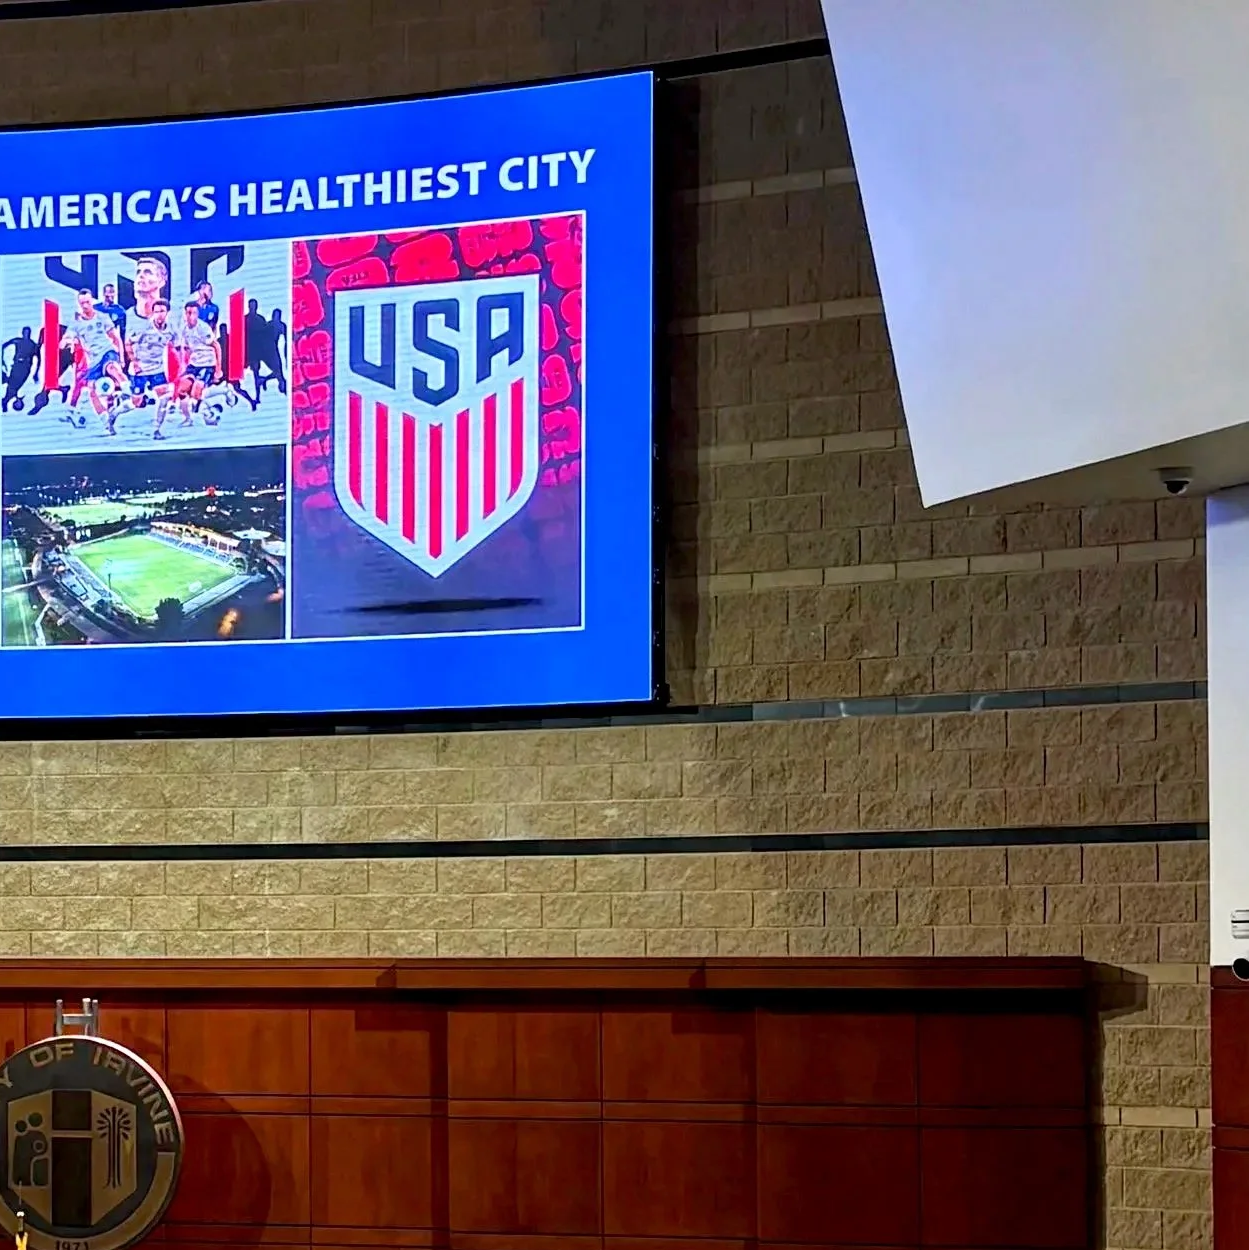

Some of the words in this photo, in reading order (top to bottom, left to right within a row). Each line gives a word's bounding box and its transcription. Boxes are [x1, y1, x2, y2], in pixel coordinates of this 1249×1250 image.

[229, 160, 487, 217] HEALTHIEST
[498, 149, 597, 192] CITY
[349, 291, 525, 407] USA
[29, 1042, 75, 1068] OF
[93, 1046, 175, 1145] IRVINE
